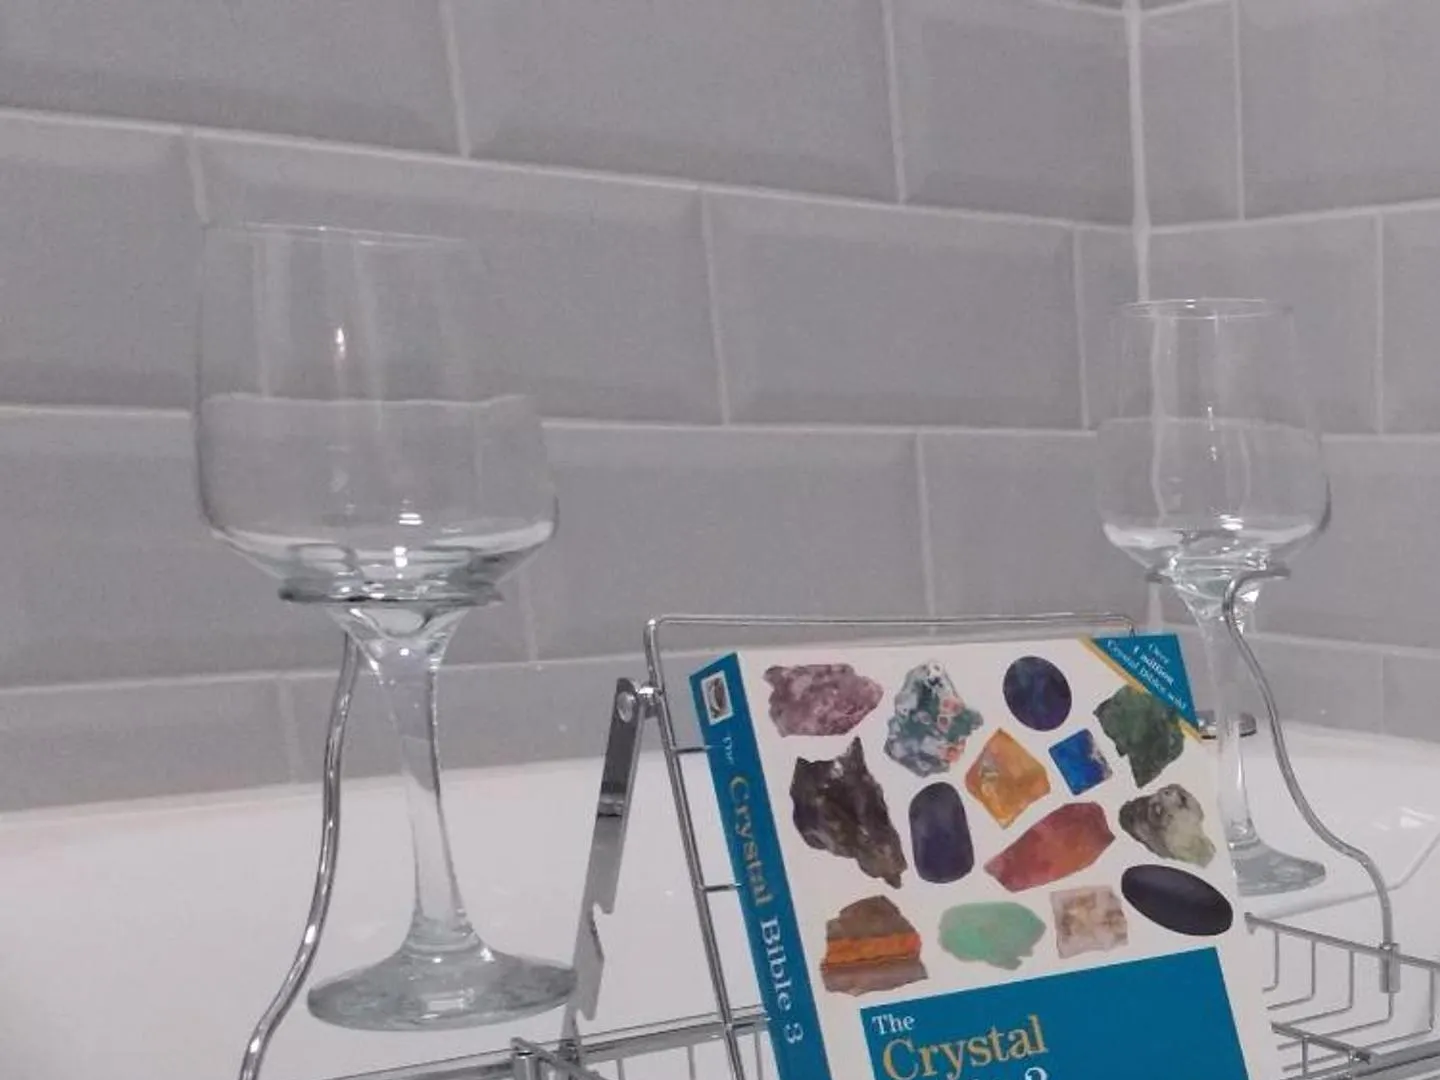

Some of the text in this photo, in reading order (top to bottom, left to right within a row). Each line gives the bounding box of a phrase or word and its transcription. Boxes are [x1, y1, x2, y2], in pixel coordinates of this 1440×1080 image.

[730, 775, 774, 906] Crystal
[760, 916, 793, 1012] Bible
[783, 1022, 804, 1045] 3
[871, 1013, 915, 1035] The
